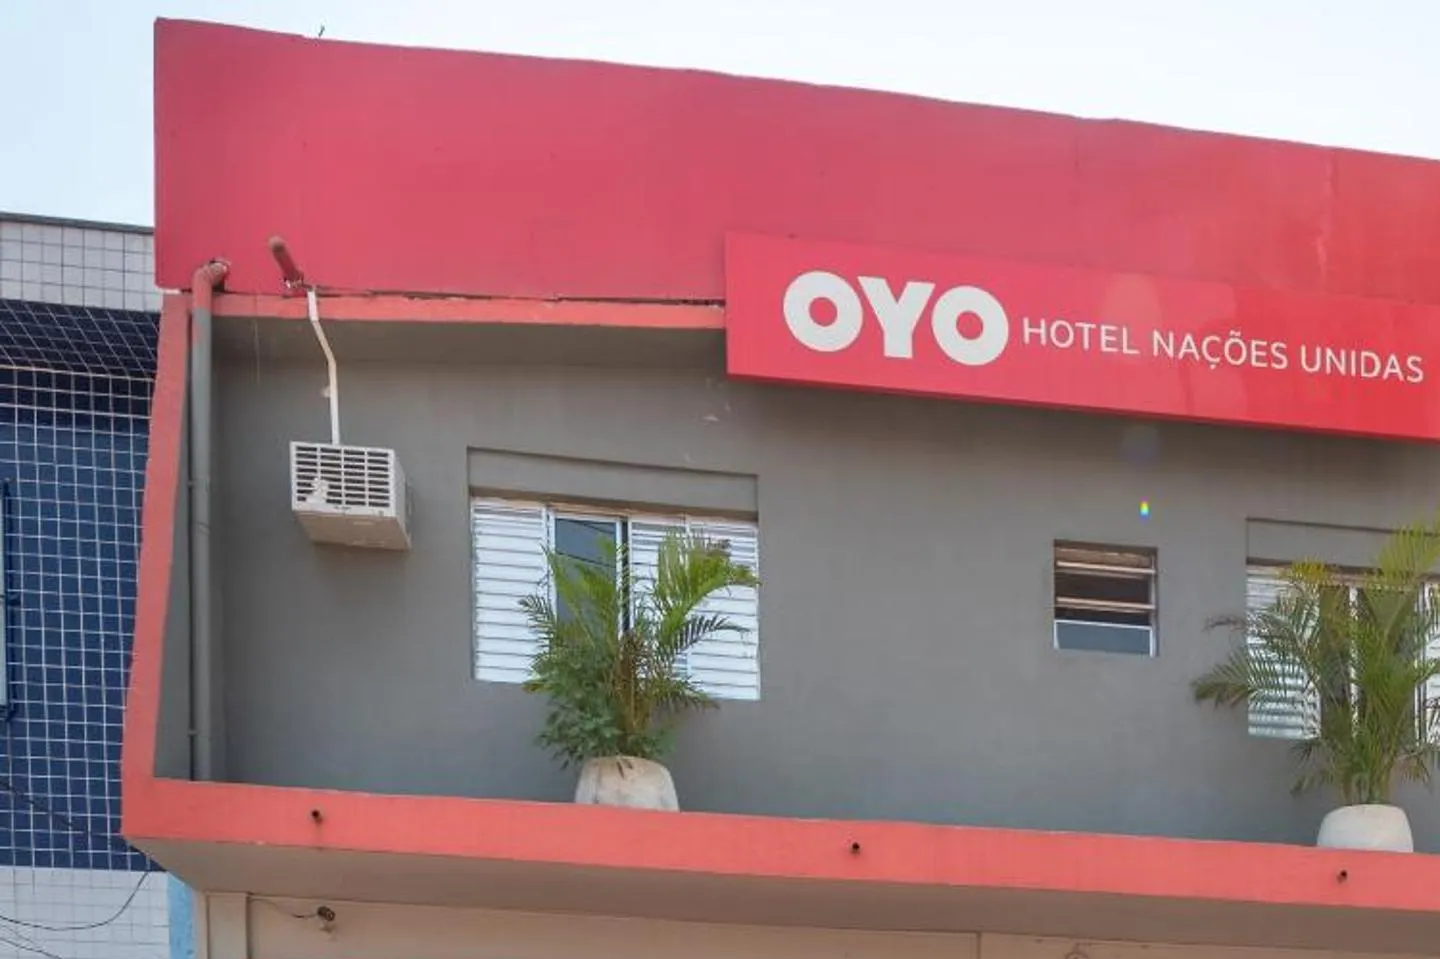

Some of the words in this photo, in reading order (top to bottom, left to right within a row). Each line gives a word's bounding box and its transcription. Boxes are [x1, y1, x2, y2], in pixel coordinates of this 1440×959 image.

[783, 270, 1009, 366] OYO
[1022, 317, 1140, 355] HOTEL
[1152, 329, 1288, 369] NAÇÕES
[1300, 344, 1424, 383] UNIDAS
